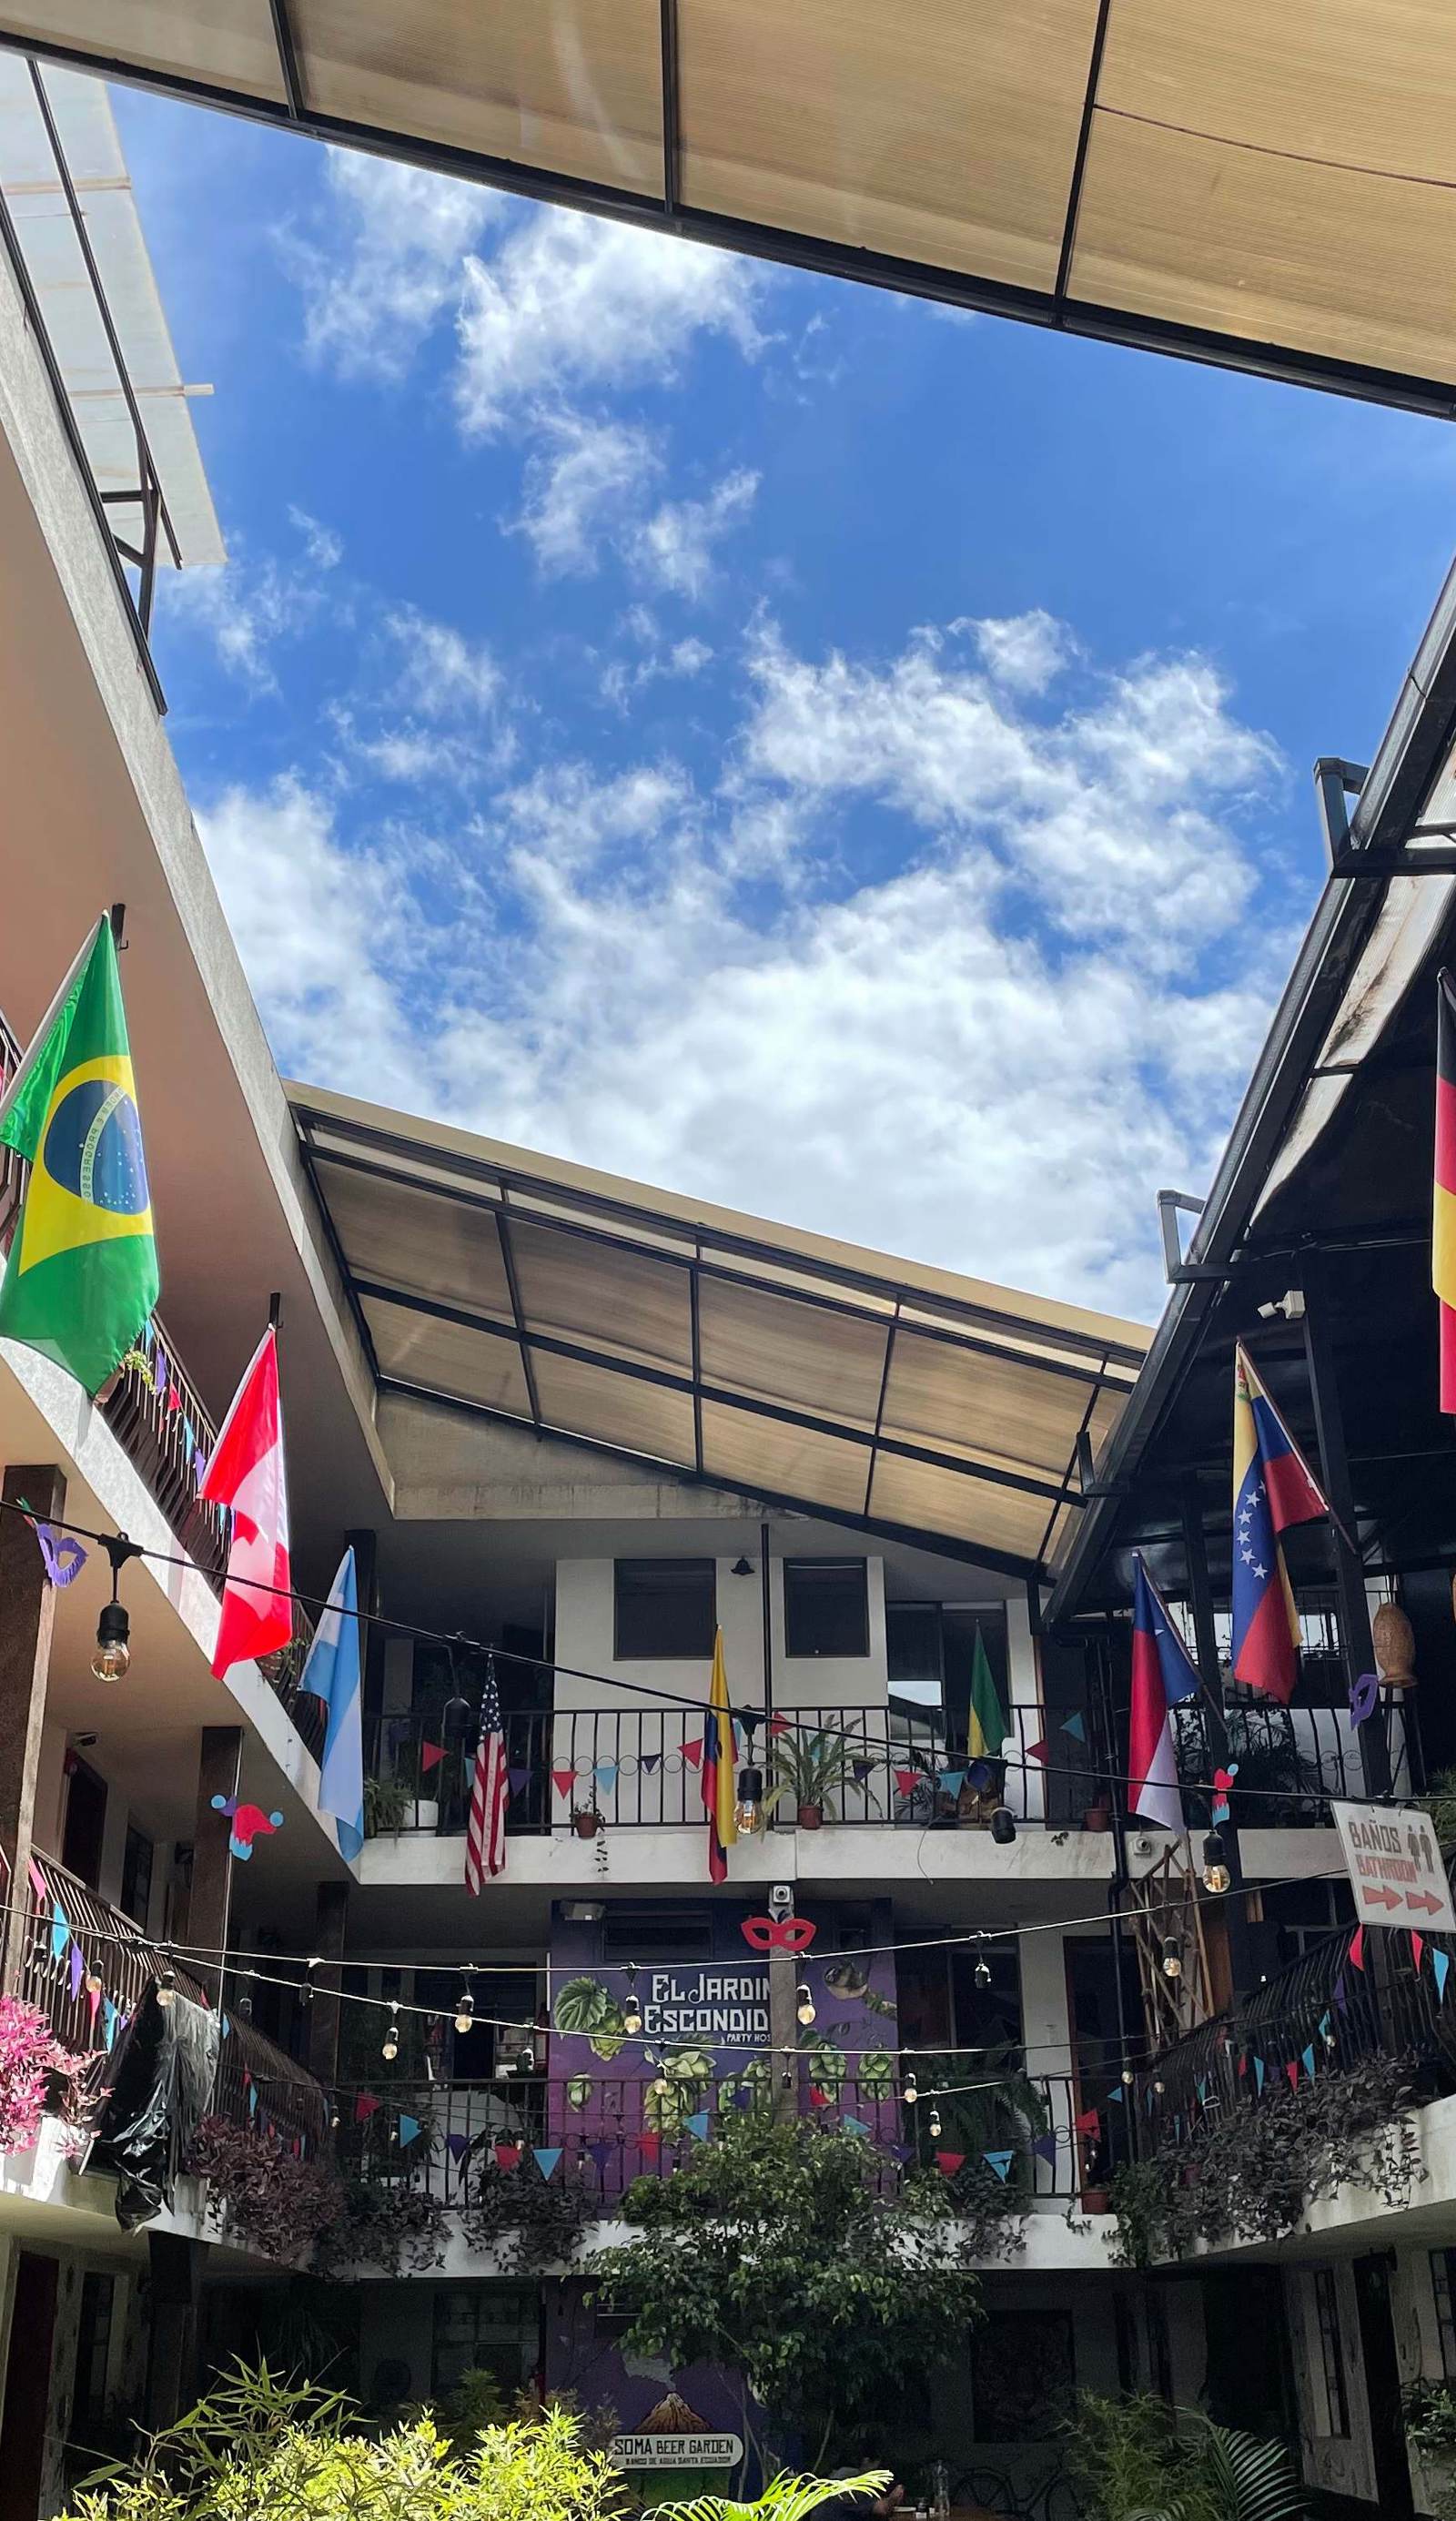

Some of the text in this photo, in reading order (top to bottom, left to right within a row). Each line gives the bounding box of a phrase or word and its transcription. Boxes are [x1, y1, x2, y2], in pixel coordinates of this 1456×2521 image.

[1348, 1818, 1402, 1854] BAÑOS
[652, 1974, 686, 2003] EL
[643, 2004, 769, 2034] ESCONDID
[726, 2033, 771, 2043] PARTY HOS
[614, 2438, 733, 2455] SOMA BEER GARDEN
